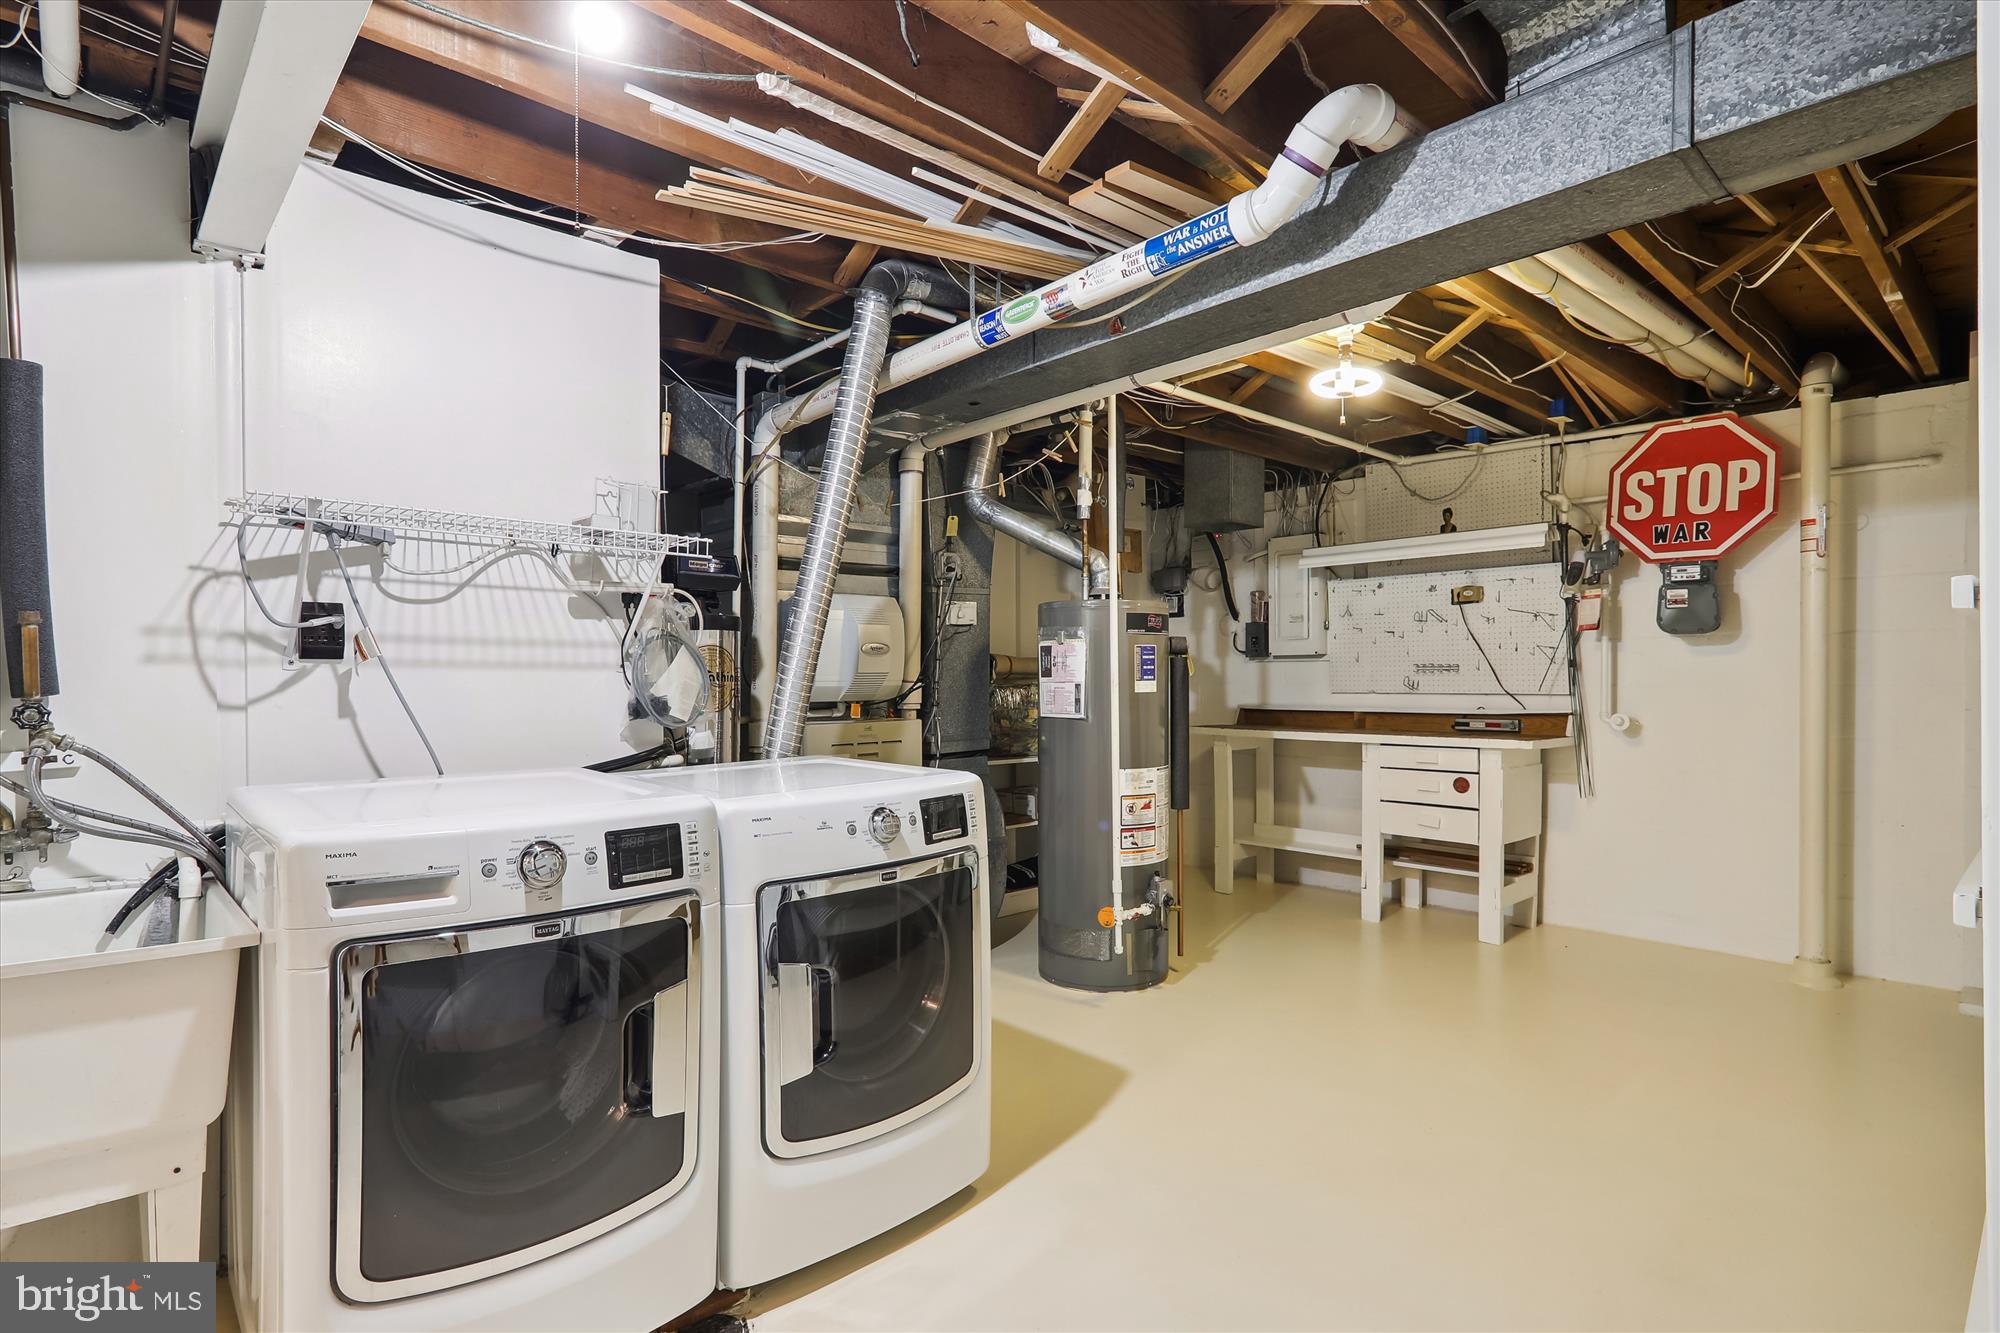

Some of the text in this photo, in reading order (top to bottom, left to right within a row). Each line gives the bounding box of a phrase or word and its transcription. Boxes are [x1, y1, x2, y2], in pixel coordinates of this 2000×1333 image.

[1163, 210, 1227, 246] WAR is NOT
[1166, 245, 1177, 255] the
[1177, 225, 1231, 256] ANSWER
[1120, 264, 1147, 279] RIGHT
[1126, 258, 1140, 268] THE
[1623, 459, 1761, 521] STOP
[1652, 521, 1711, 545] WAR
[325, 852, 358, 860] MAXIMA
[536, 925, 560, 935] MAYTAG
